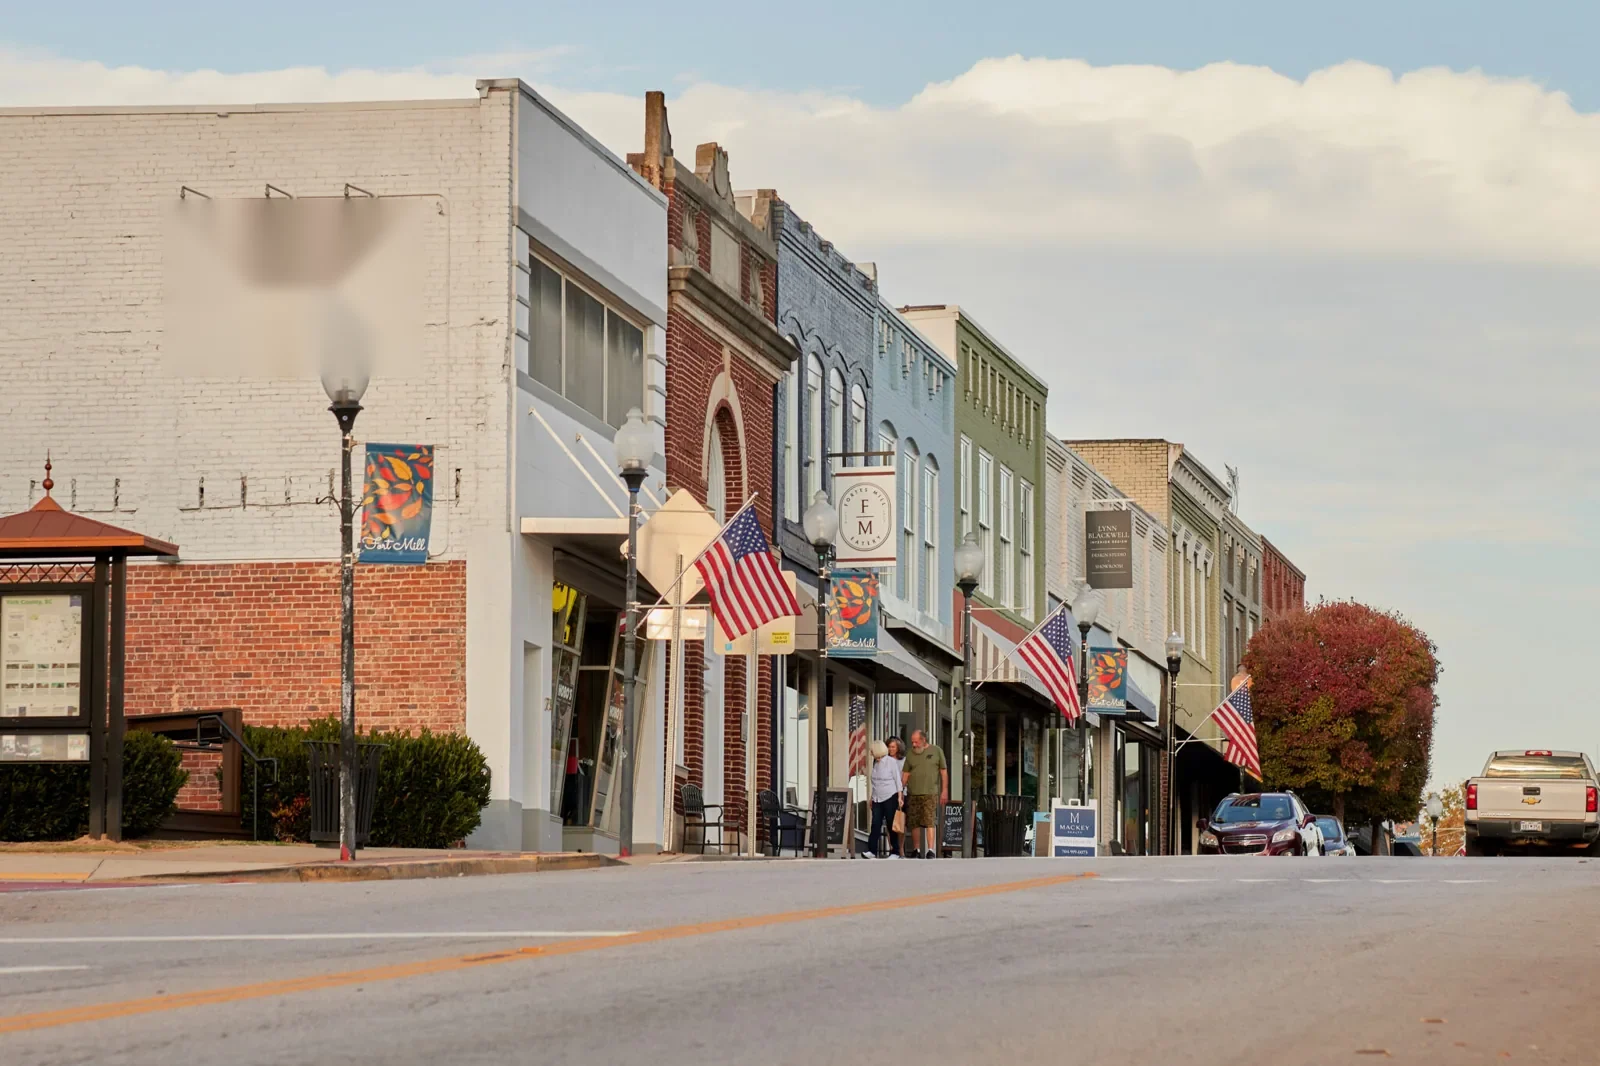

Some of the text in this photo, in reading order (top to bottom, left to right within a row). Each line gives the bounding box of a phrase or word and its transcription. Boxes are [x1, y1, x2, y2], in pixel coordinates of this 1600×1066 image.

[844, 488, 886, 507] FORTES MILL
[861, 499, 869, 514] F
[858, 520, 873, 535] M
[362, 536, 426, 551] Fort Mill
[850, 536, 881, 546] EATERY
[829, 637, 876, 648] Fort Mill
[1070, 812, 1080, 824] M
